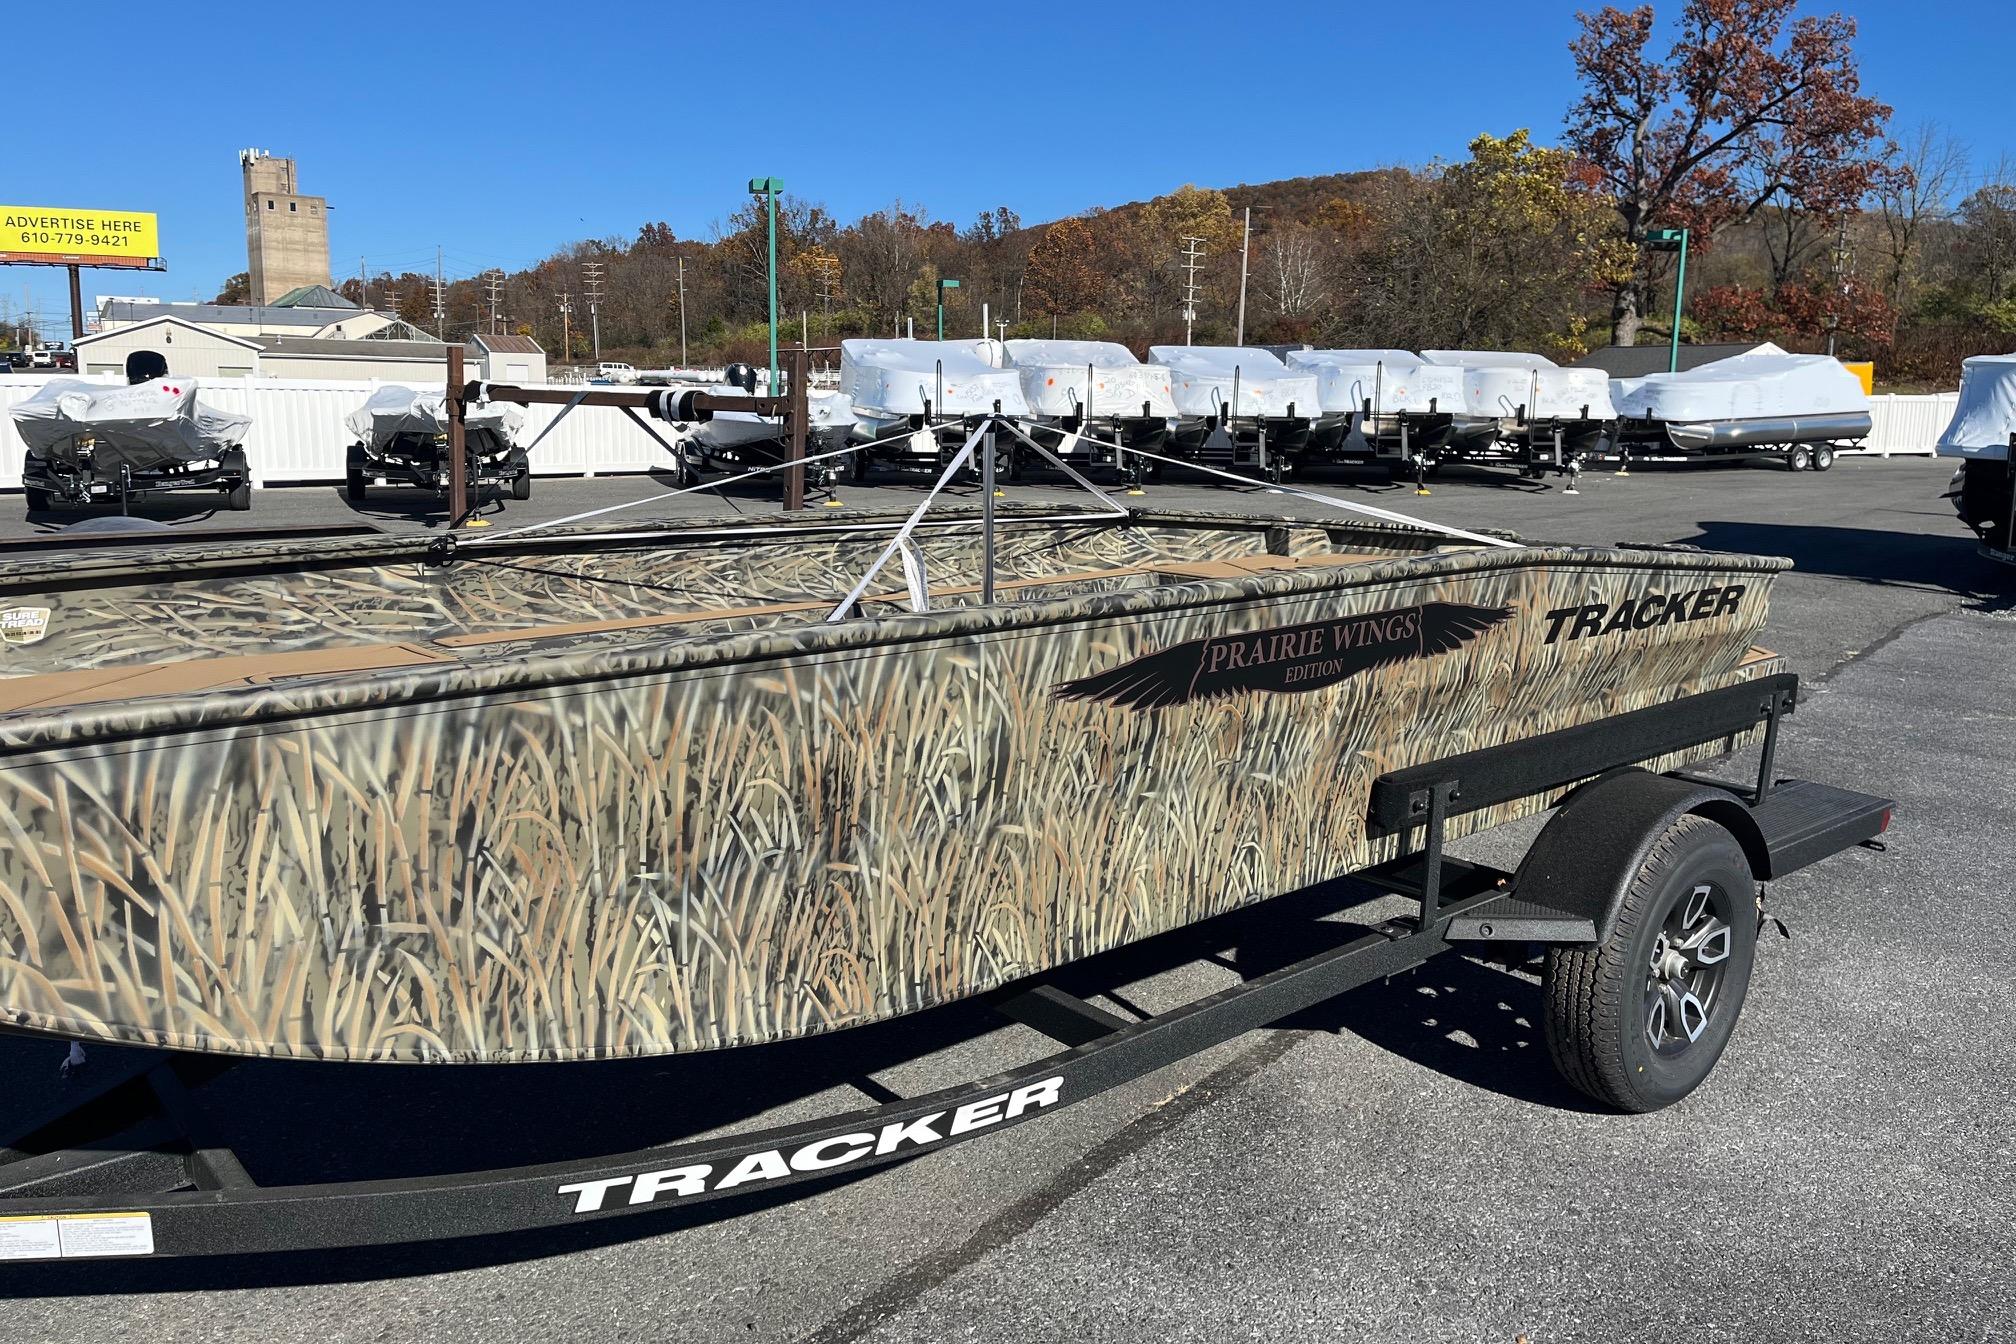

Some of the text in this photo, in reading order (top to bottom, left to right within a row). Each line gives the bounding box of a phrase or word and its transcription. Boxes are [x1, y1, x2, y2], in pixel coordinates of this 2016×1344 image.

[5, 216, 142, 233] ADVERTISE HERE
[21, 232, 129, 247] 610-779-9421
[0, 618, 44, 629] TREAD
[2, 611, 40, 621] SURE
[1543, 584, 1746, 645] TRACKER
[1208, 612, 1416, 674] PRAIRIE WINGS
[1284, 658, 1344, 684] EDITION
[557, 1075, 1065, 1214] TRACKER
